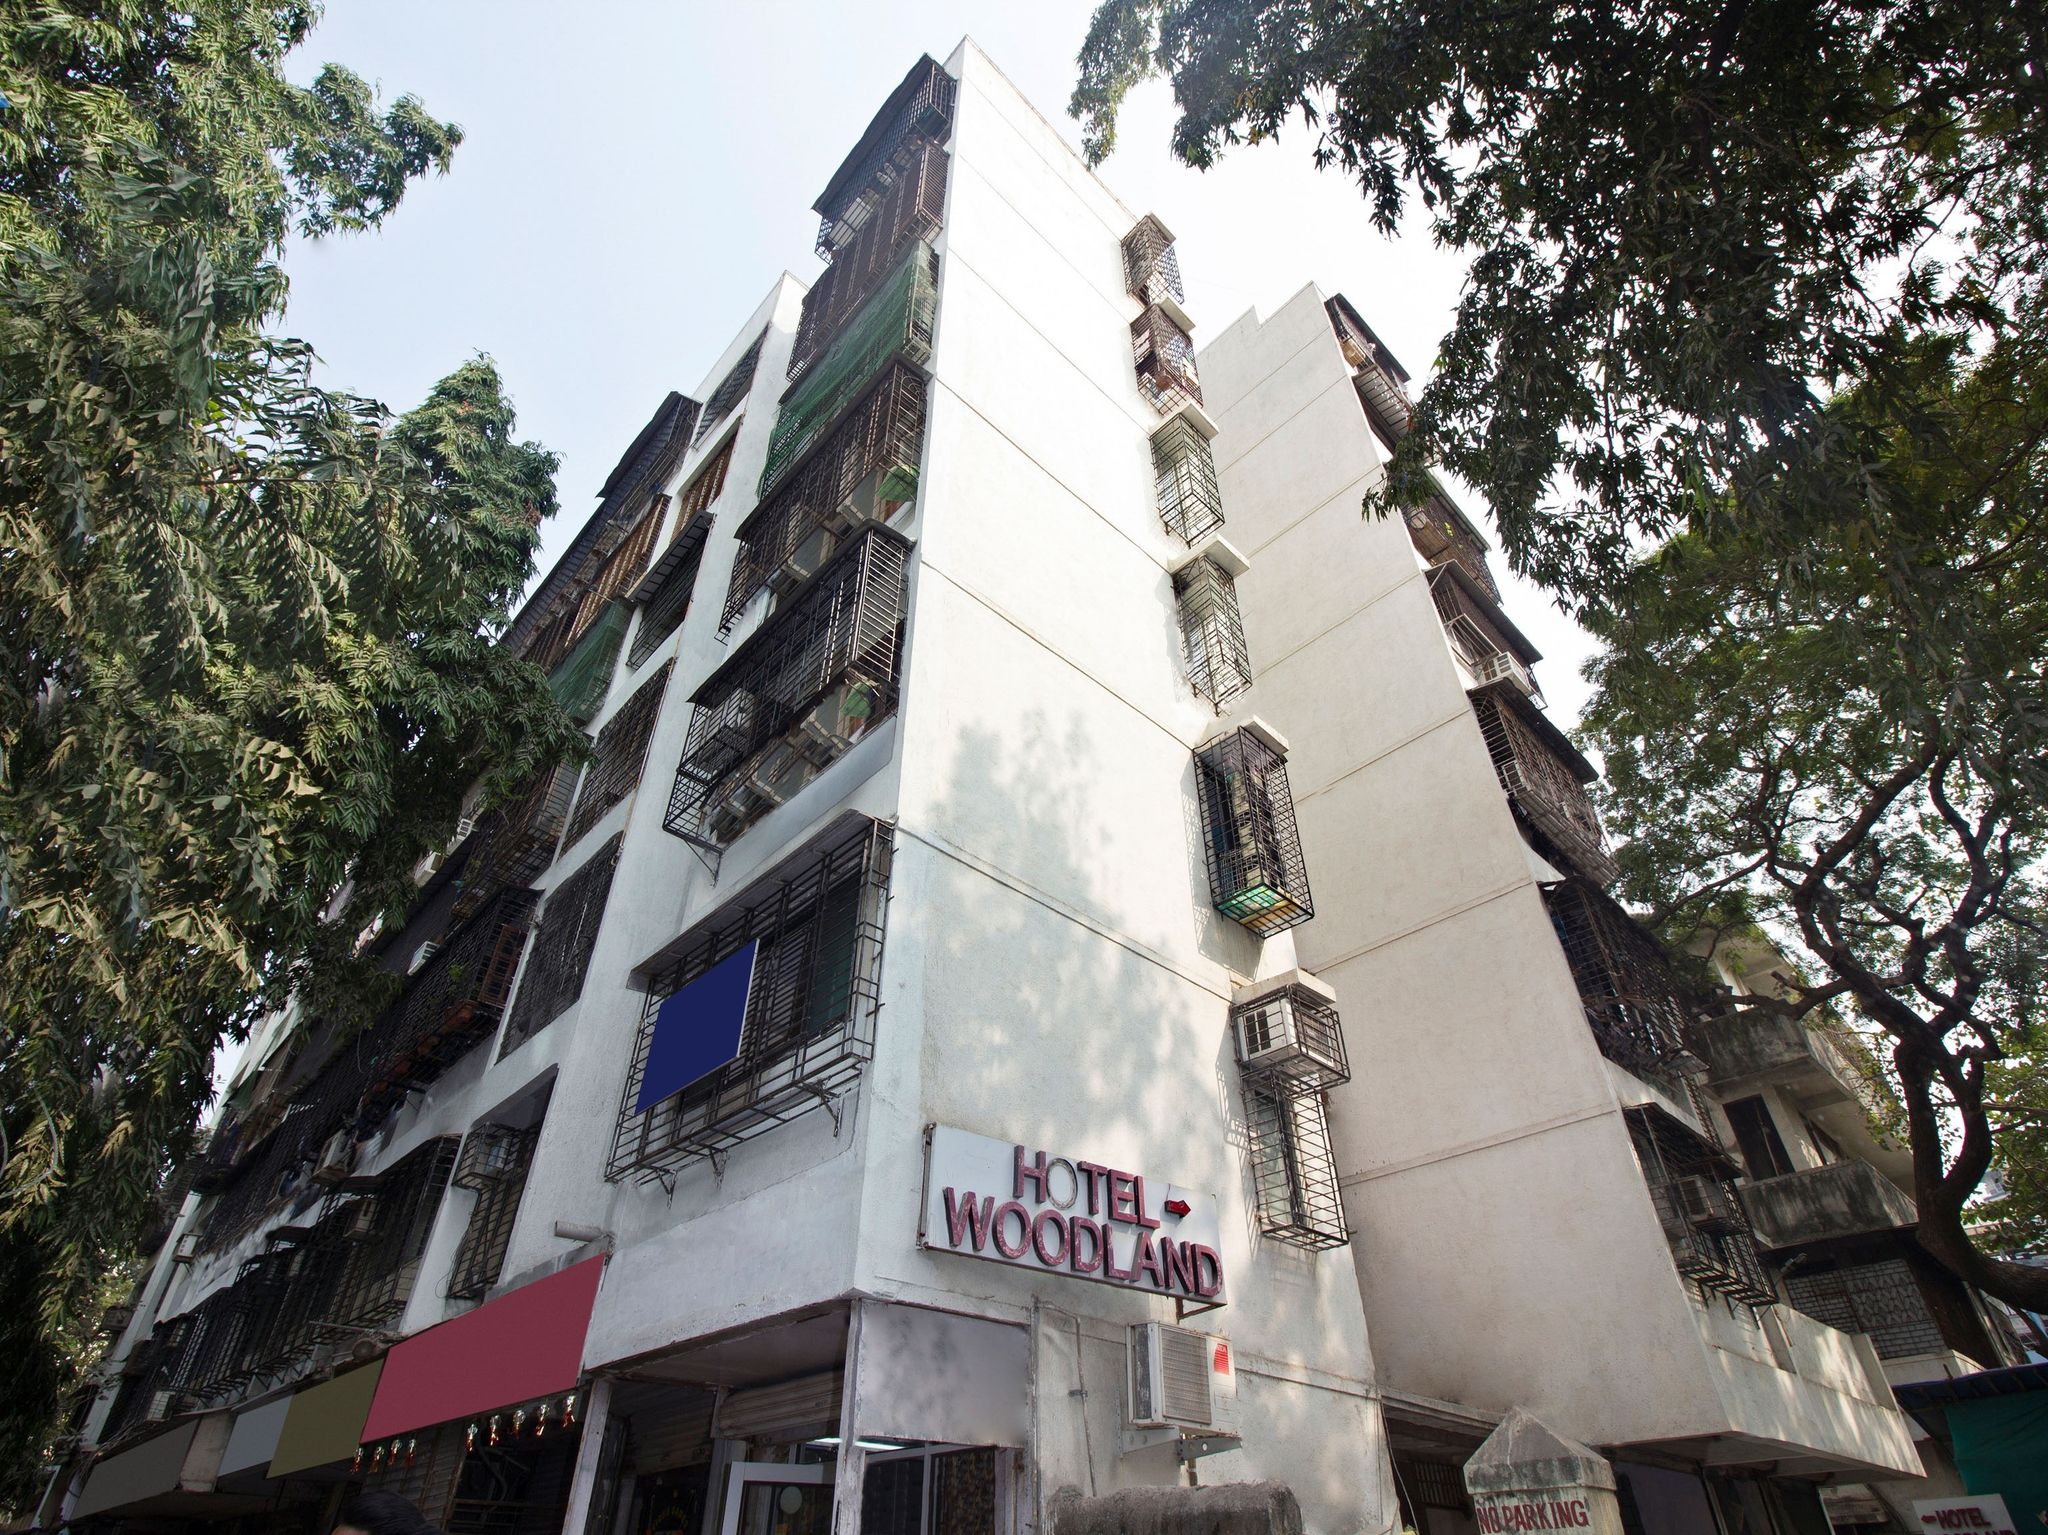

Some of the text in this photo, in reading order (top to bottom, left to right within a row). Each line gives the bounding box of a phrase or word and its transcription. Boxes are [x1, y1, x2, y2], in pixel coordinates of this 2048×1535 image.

[1013, 1144, 1160, 1229] HOTEL
[943, 1186, 1223, 1297] WOODLAND
[1476, 1500, 1589, 1534] NO PARKING
[1935, 1508, 1991, 1529] HOTEL
